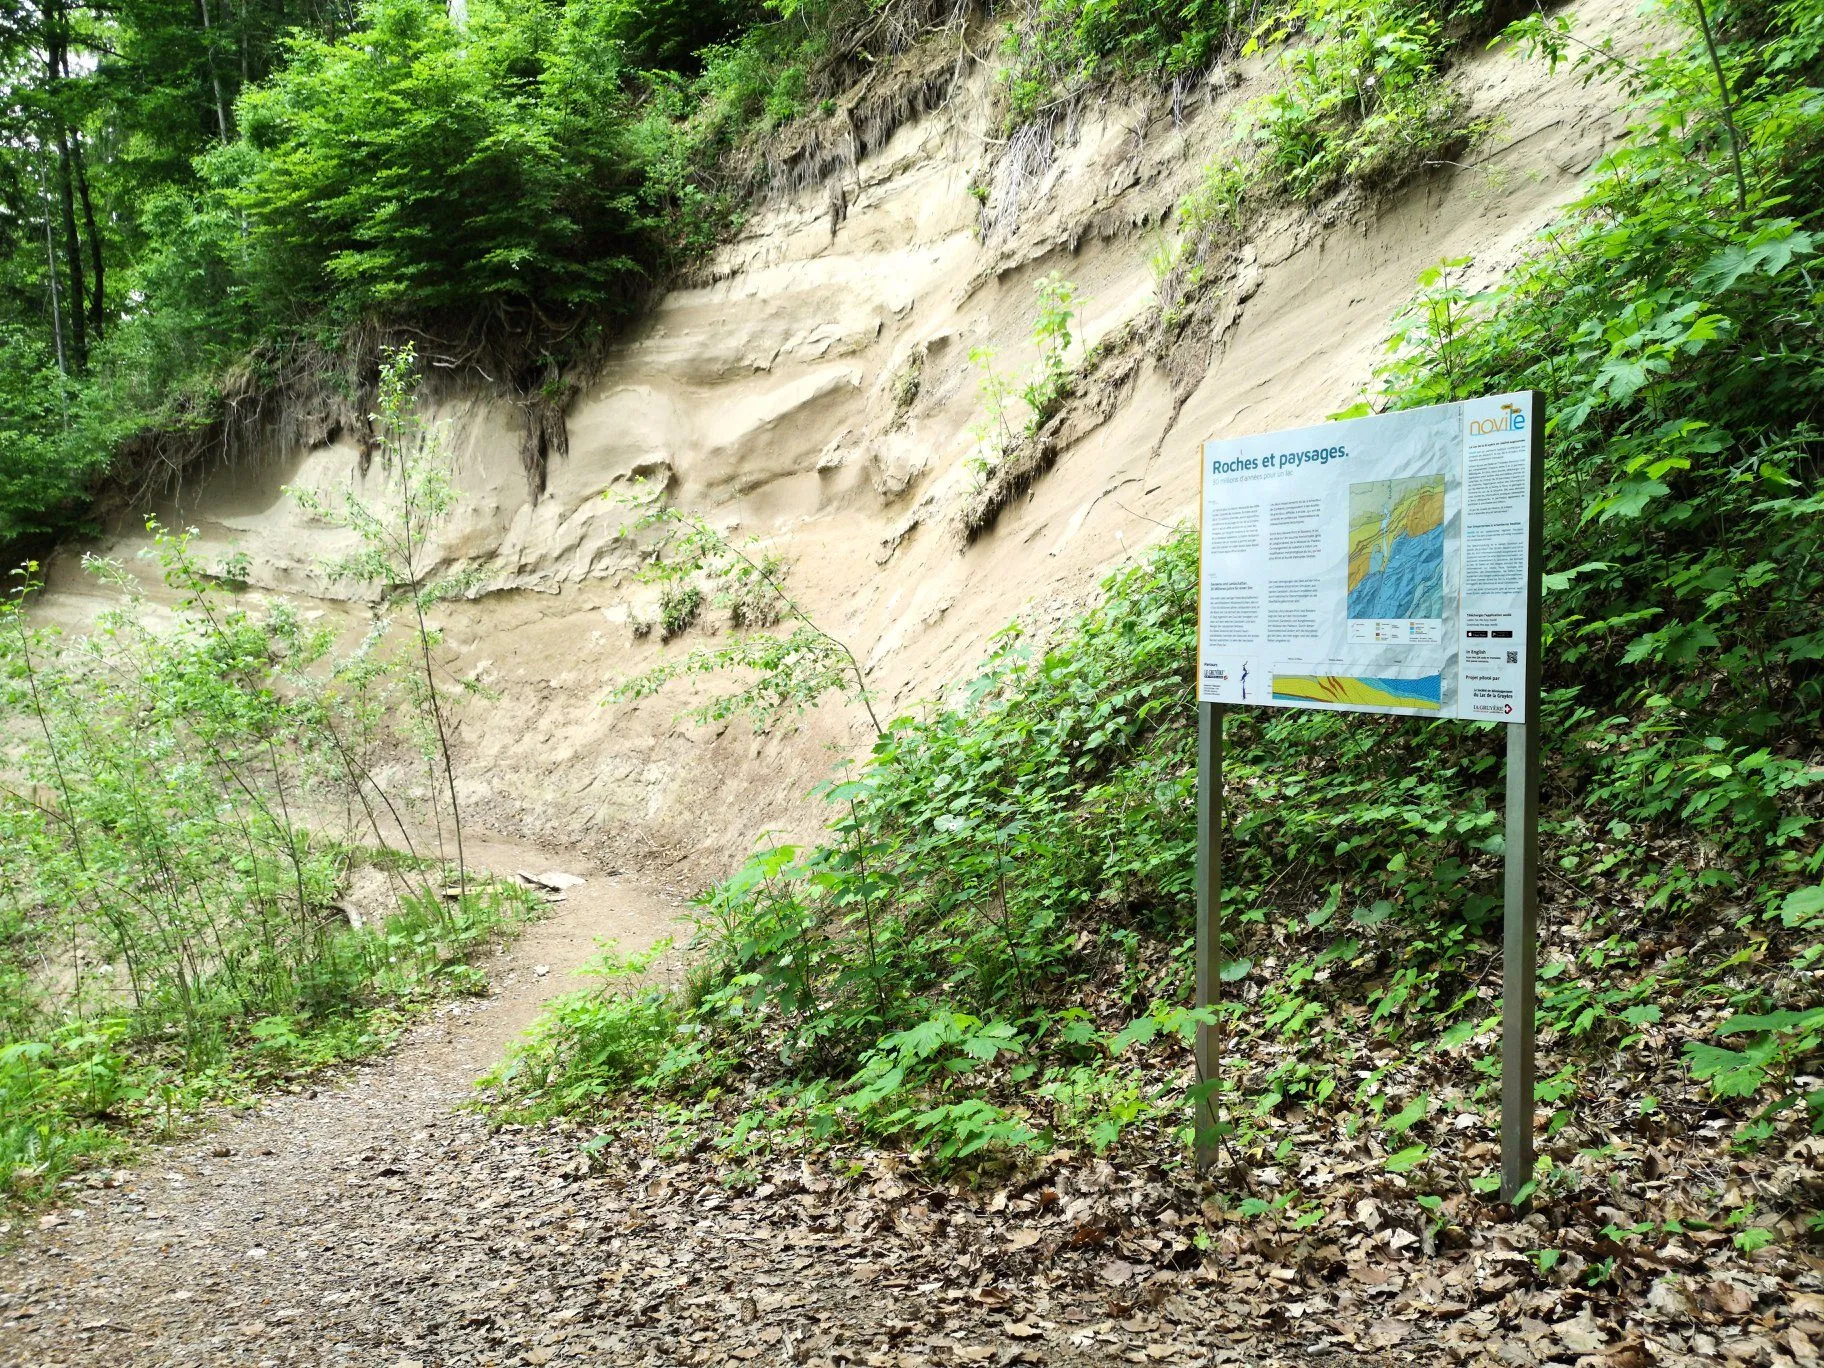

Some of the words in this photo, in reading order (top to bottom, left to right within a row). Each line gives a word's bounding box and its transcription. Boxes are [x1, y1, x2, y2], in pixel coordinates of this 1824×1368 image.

[1212, 457, 1258, 475] Roches
[1262, 453, 1276, 468] et
[1279, 445, 1349, 470] paysages.
[1239, 473, 1262, 483] d'années
[1263, 472, 1276, 481] pour
[1285, 469, 1293, 477] lac
